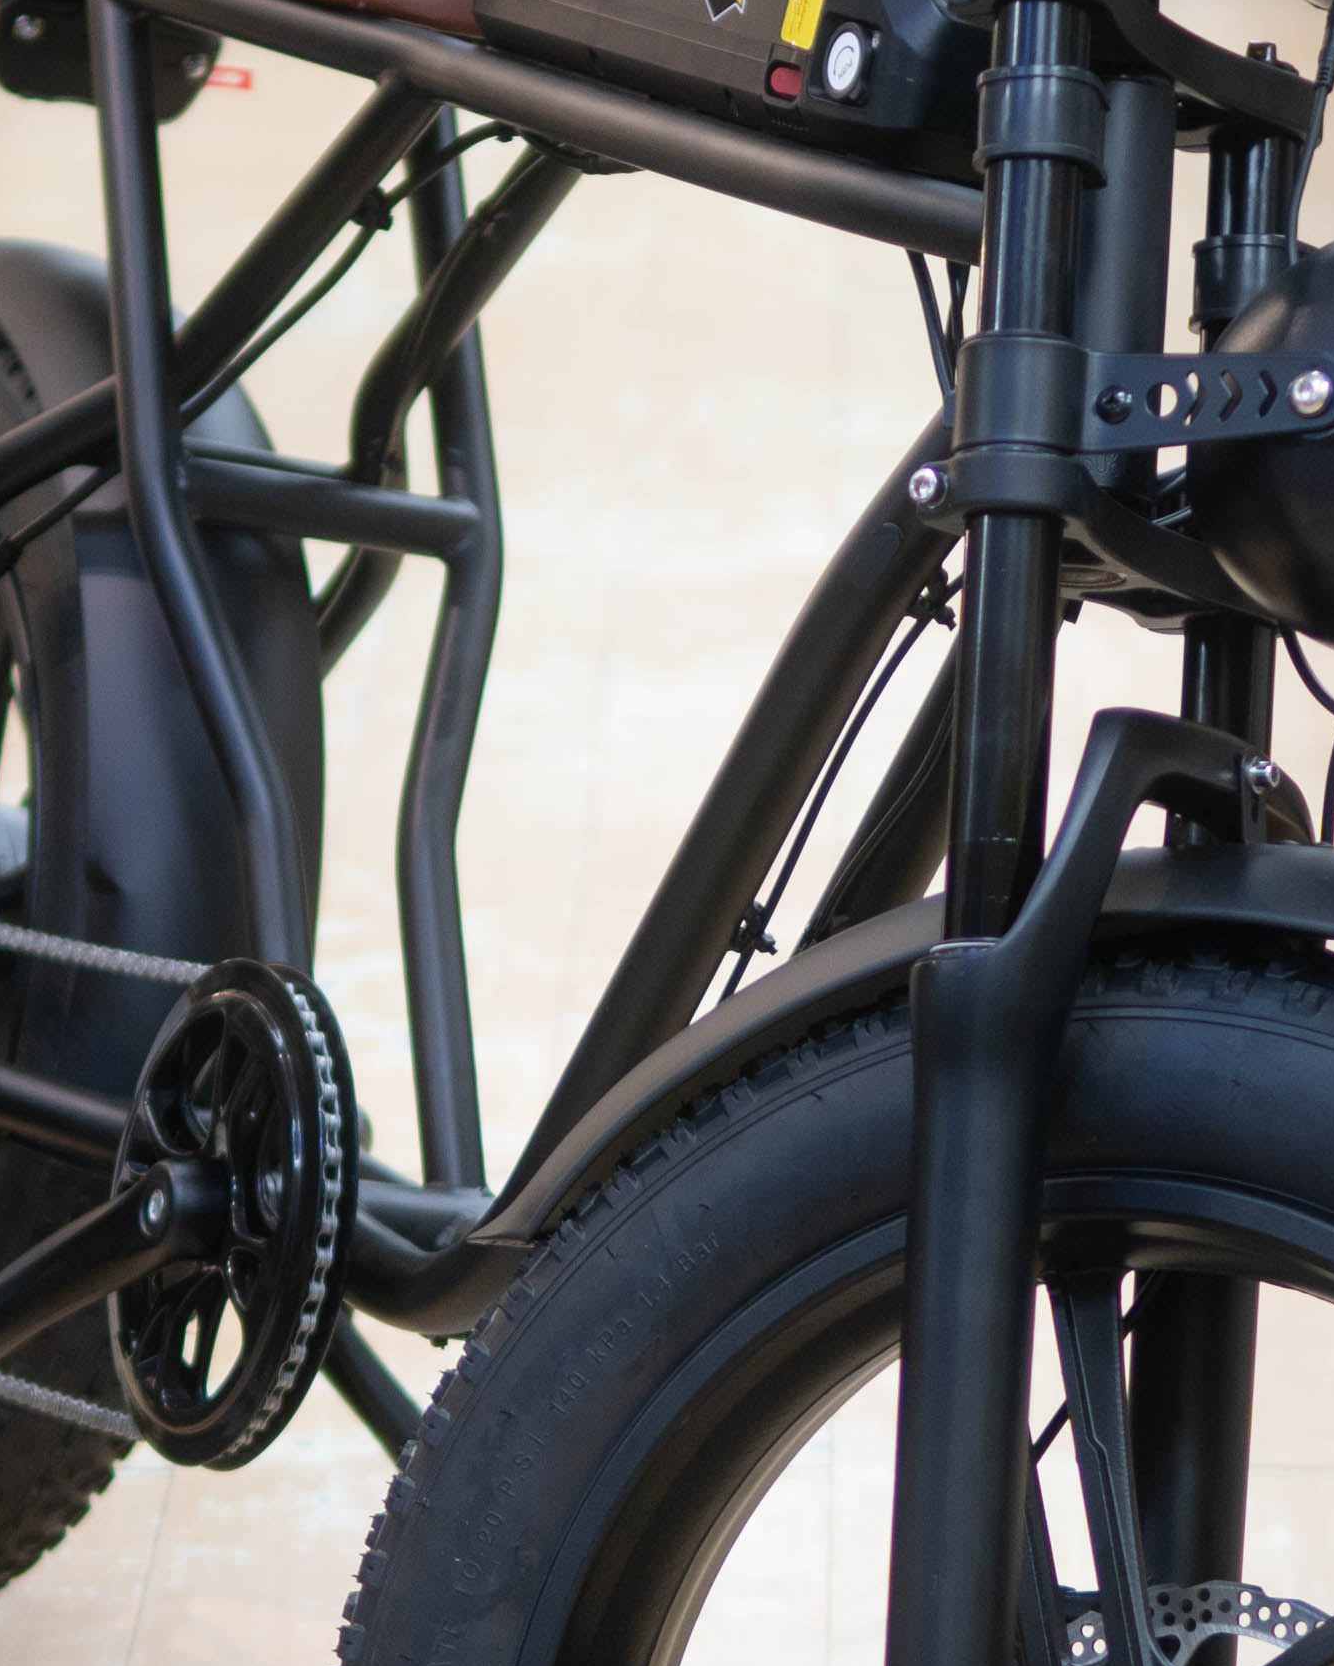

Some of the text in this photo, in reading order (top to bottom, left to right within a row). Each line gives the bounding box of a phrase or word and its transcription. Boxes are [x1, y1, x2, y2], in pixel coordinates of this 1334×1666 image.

[476, 1510, 504, 1546] 20
[584, 1316, 634, 1365] kPa
[675, 1232, 720, 1274] Bar
